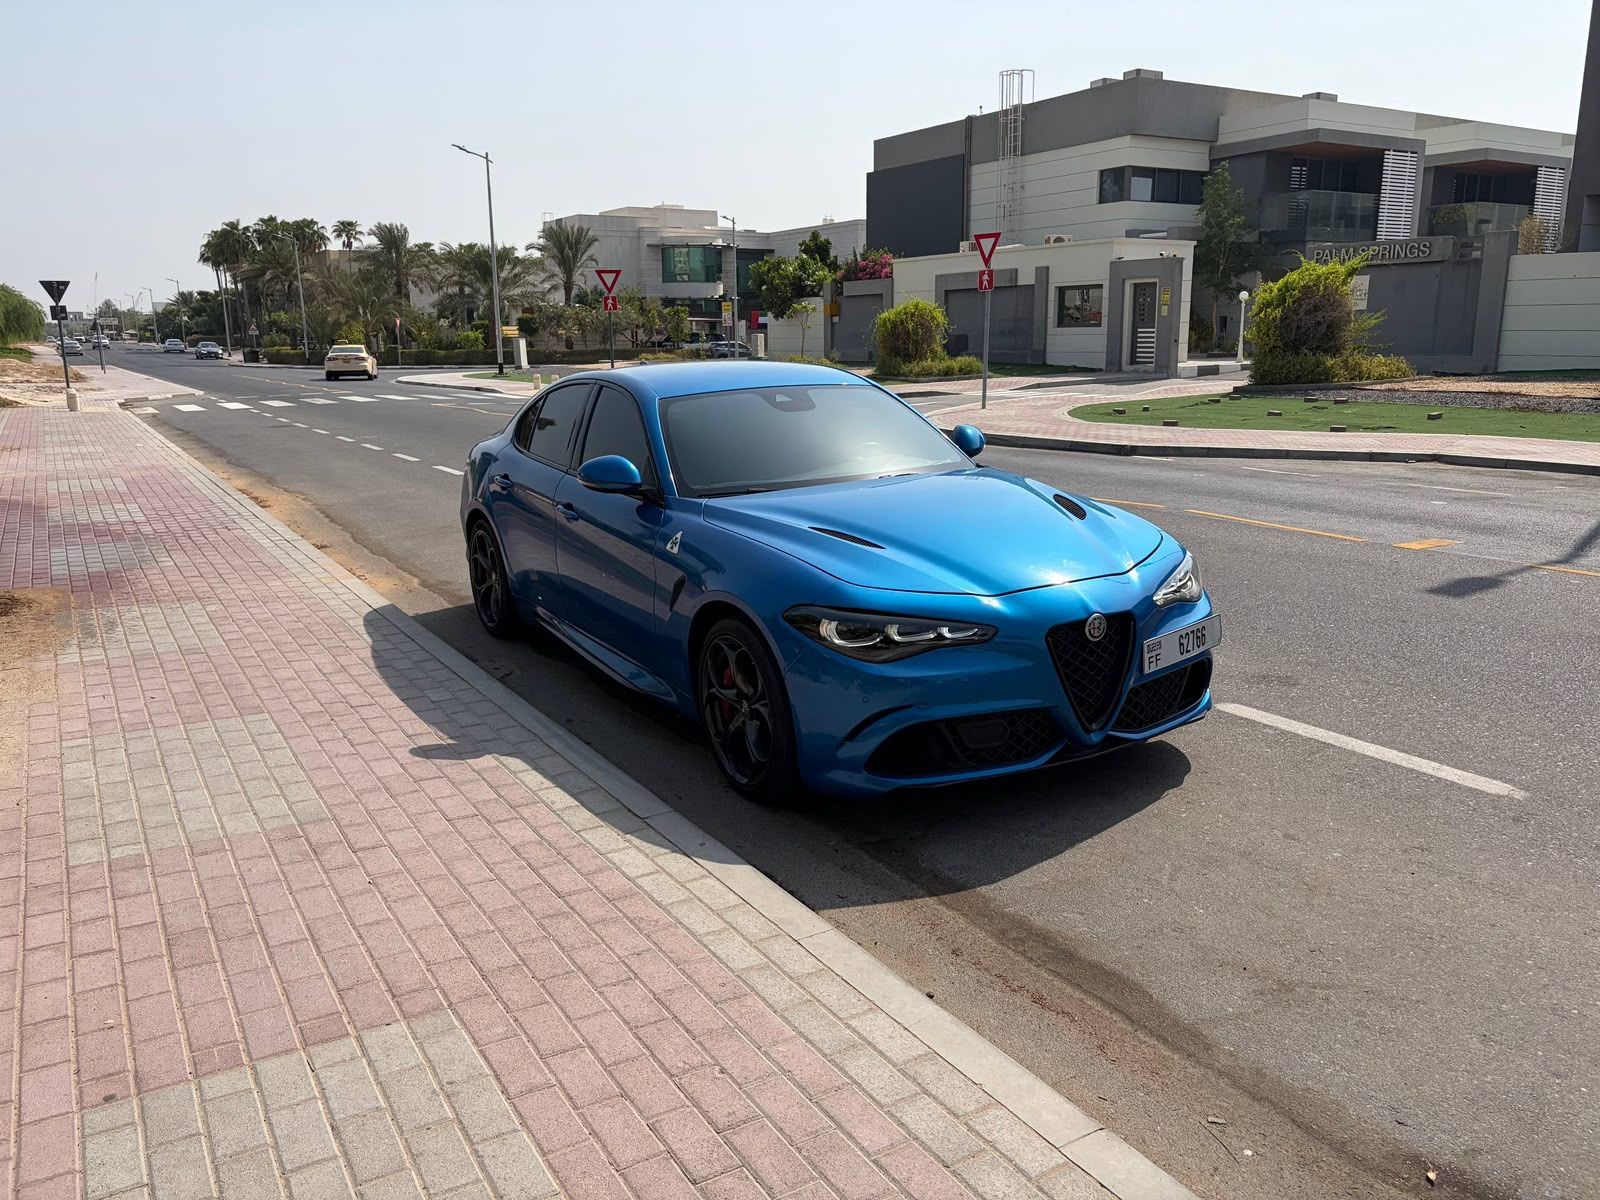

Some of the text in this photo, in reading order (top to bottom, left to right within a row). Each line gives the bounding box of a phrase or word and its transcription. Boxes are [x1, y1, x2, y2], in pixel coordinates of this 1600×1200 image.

[1314, 241, 1431, 263] PALM SPRINGS
[1178, 625, 1206, 656] 62766
[1148, 653, 1162, 670] FF
